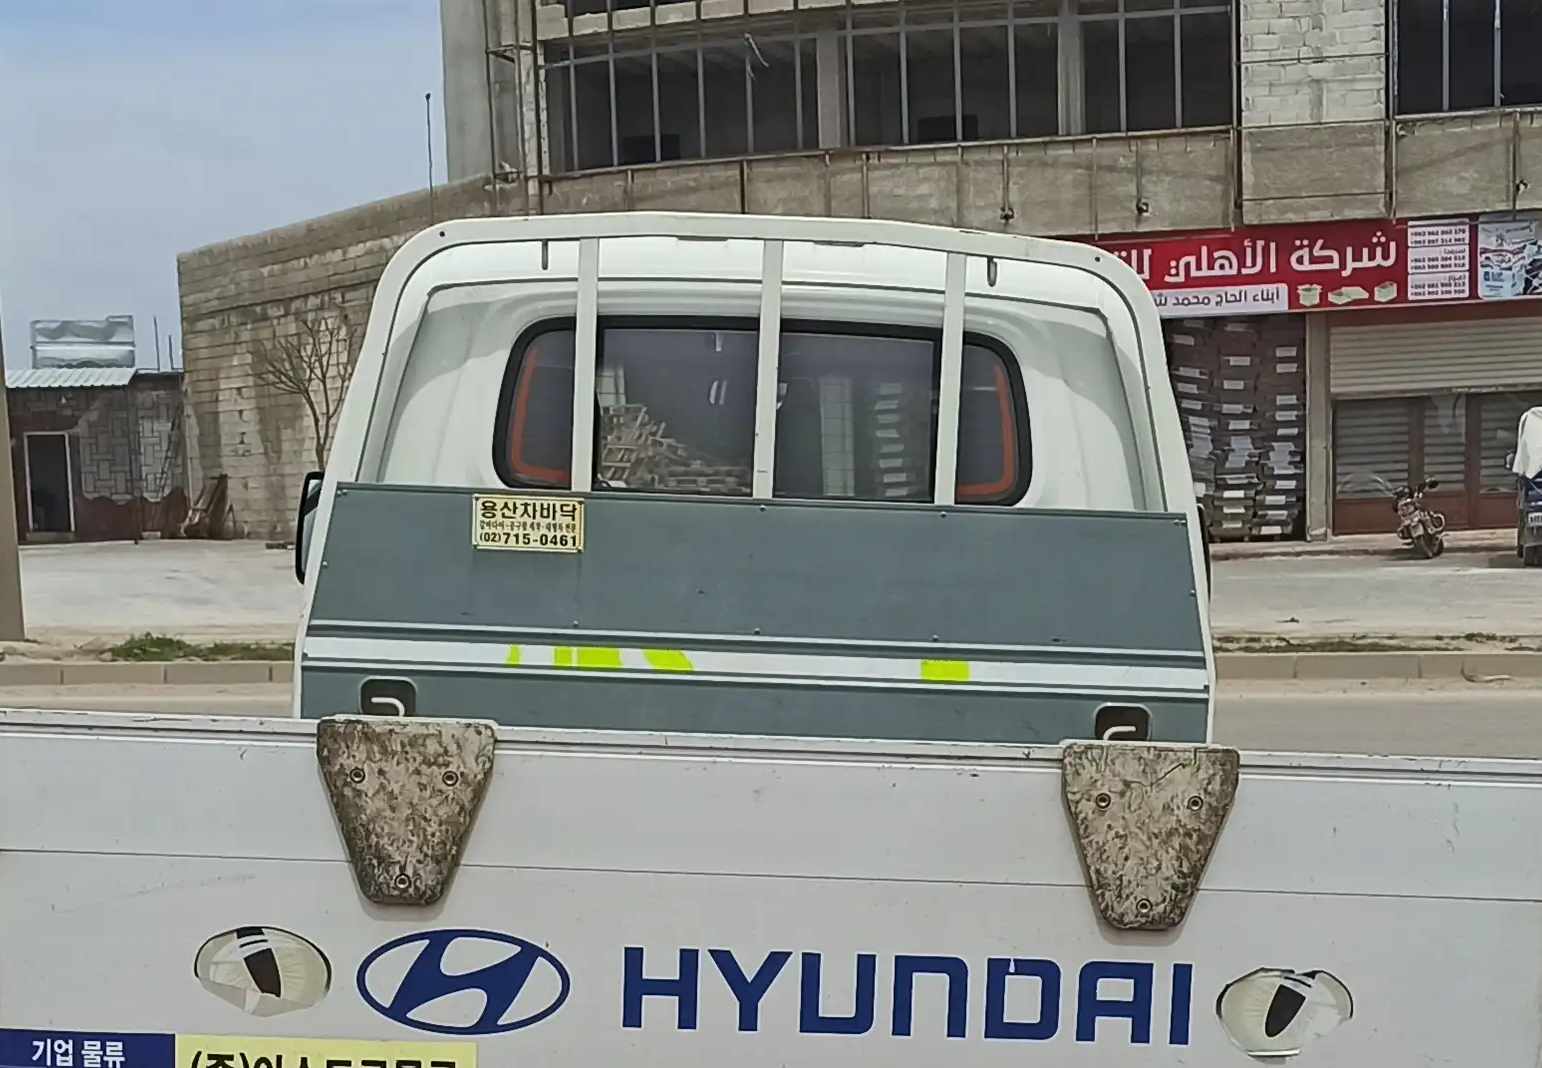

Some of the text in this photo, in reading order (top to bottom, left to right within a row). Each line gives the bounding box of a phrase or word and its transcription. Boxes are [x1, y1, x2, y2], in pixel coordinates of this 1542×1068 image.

[1164, 238, 1277, 283] الأهلي
[1290, 230, 1397, 277] شركة
[1172, 294, 1210, 307] محمد
[1215, 290, 1247, 307] الحاج
[480, 500, 577, 521] 용산차바닥
[479, 532, 577, 547] (02)715-0461
[622, 945, 1194, 1046] HYUNDAI
[32, 1039, 126, 1068] 기업 물류
